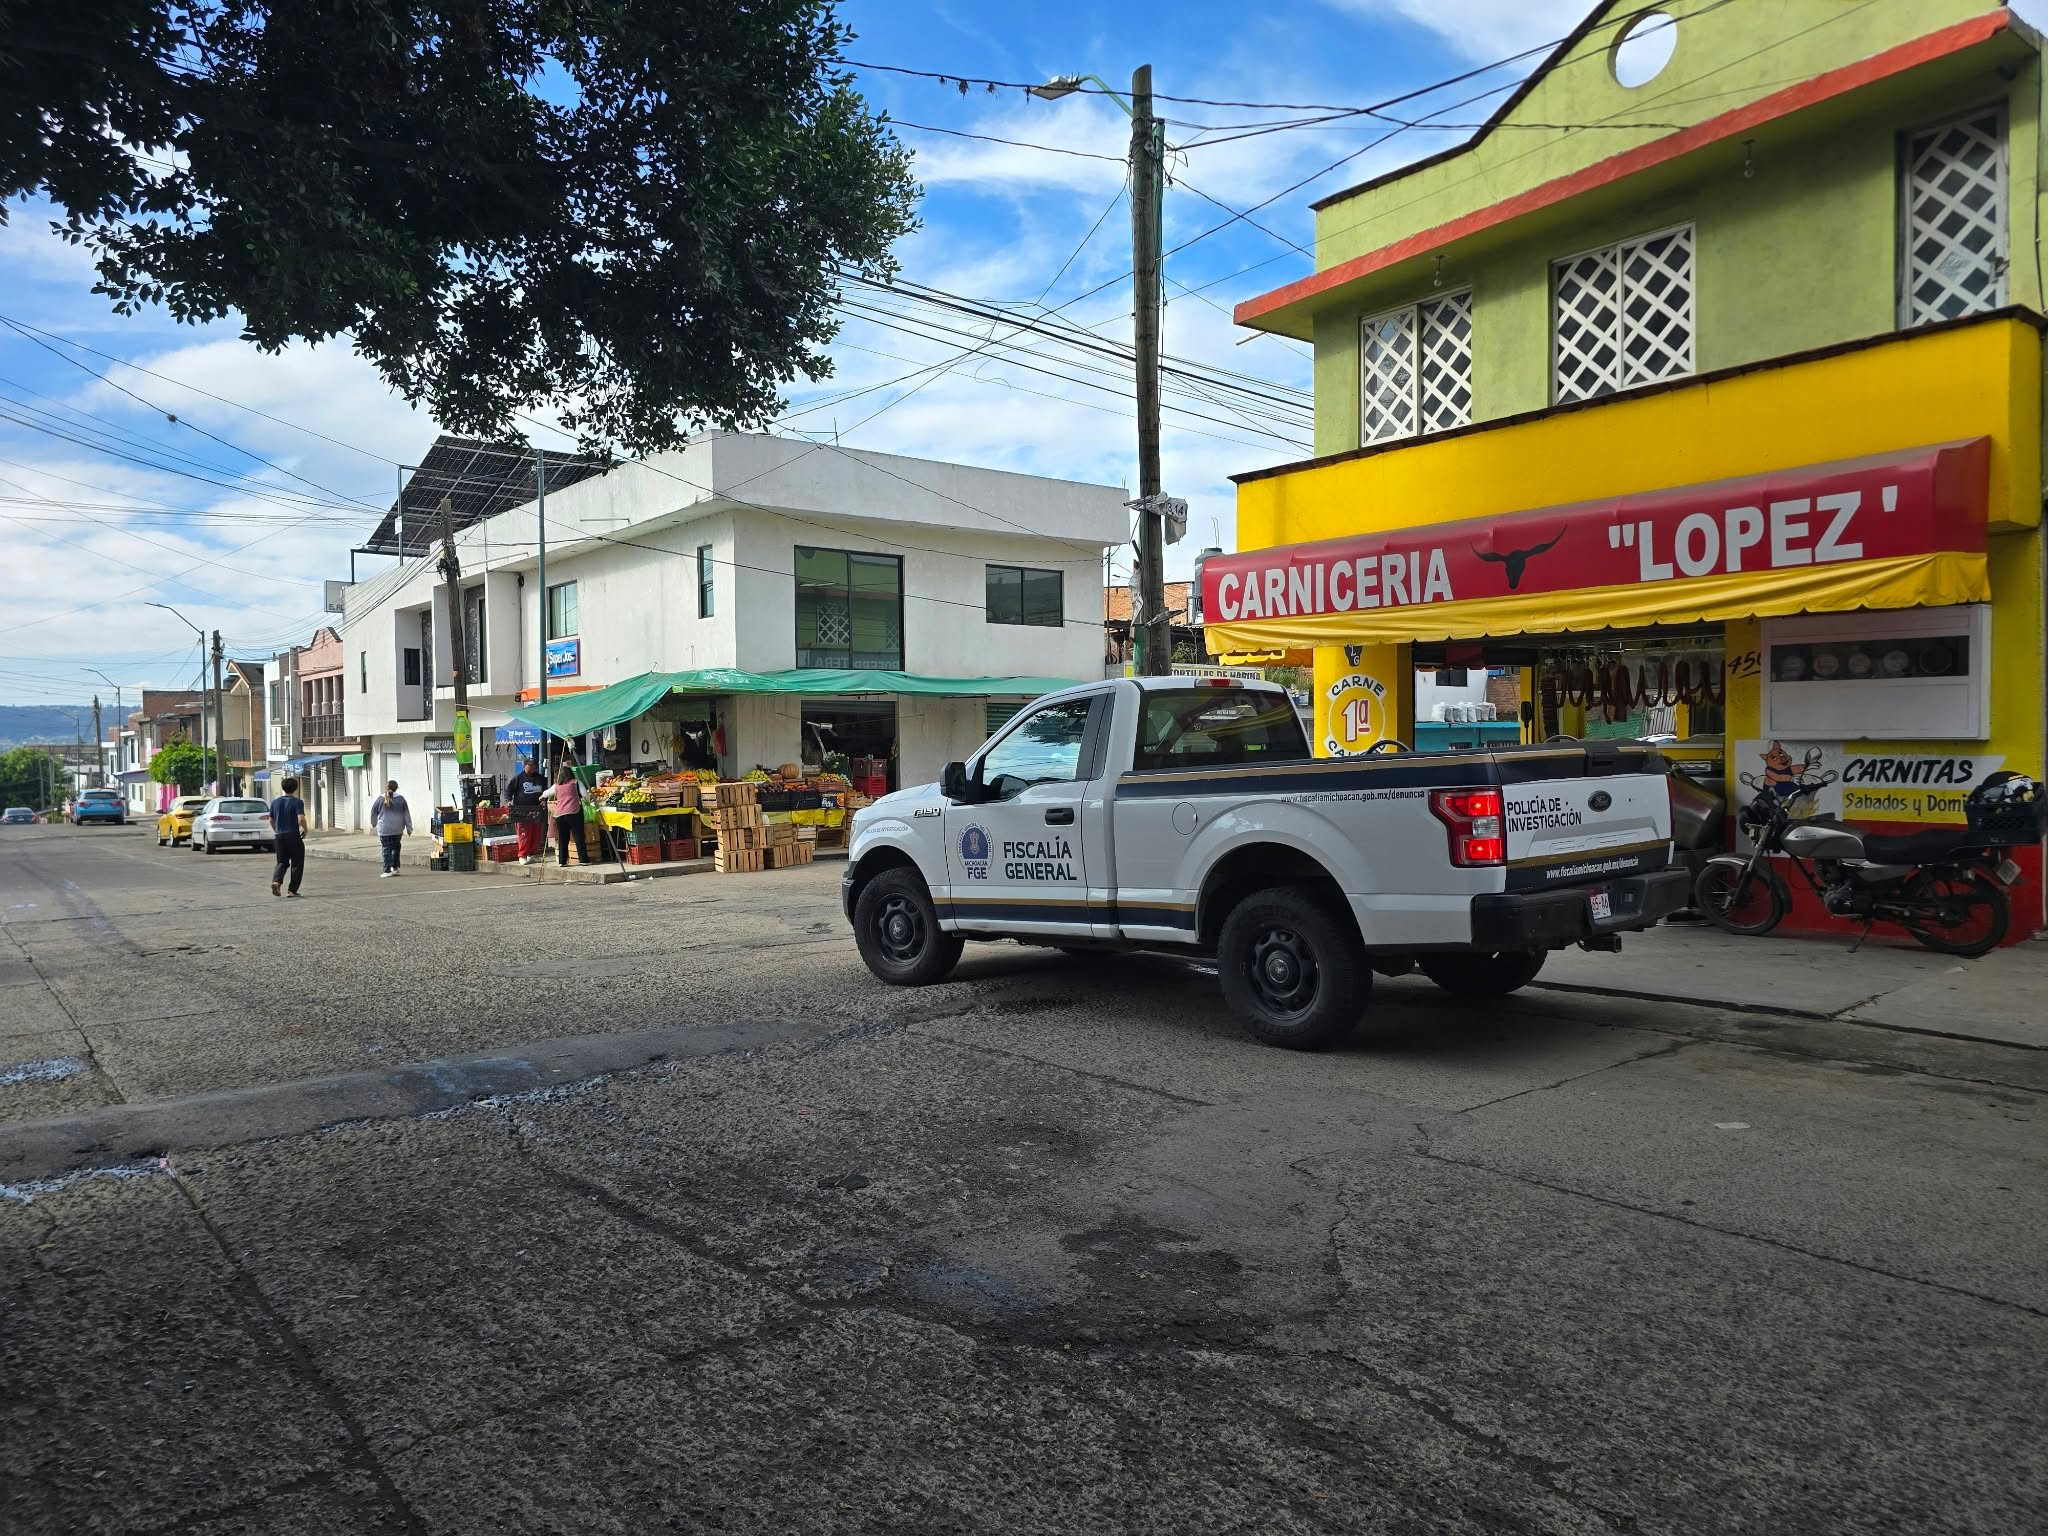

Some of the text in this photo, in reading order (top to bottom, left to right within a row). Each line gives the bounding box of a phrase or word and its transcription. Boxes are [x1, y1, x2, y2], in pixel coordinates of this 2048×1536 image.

[1219, 547, 1454, 622] CARNICERIA
[1331, 675, 1385, 697] CARNE
[1842, 758, 1974, 784] CARNITAS
[1506, 795, 1561, 817] POLICÍA DE
[1845, 792, 1908, 811] Sabados
[1912, 799, 1922, 816] y
[1507, 808, 1582, 833] INVESTIGACIÓN
[1003, 835, 1073, 859] FISCALÍA
[967, 866, 988, 880] FGE
[1004, 862, 1078, 881] GENERAL
